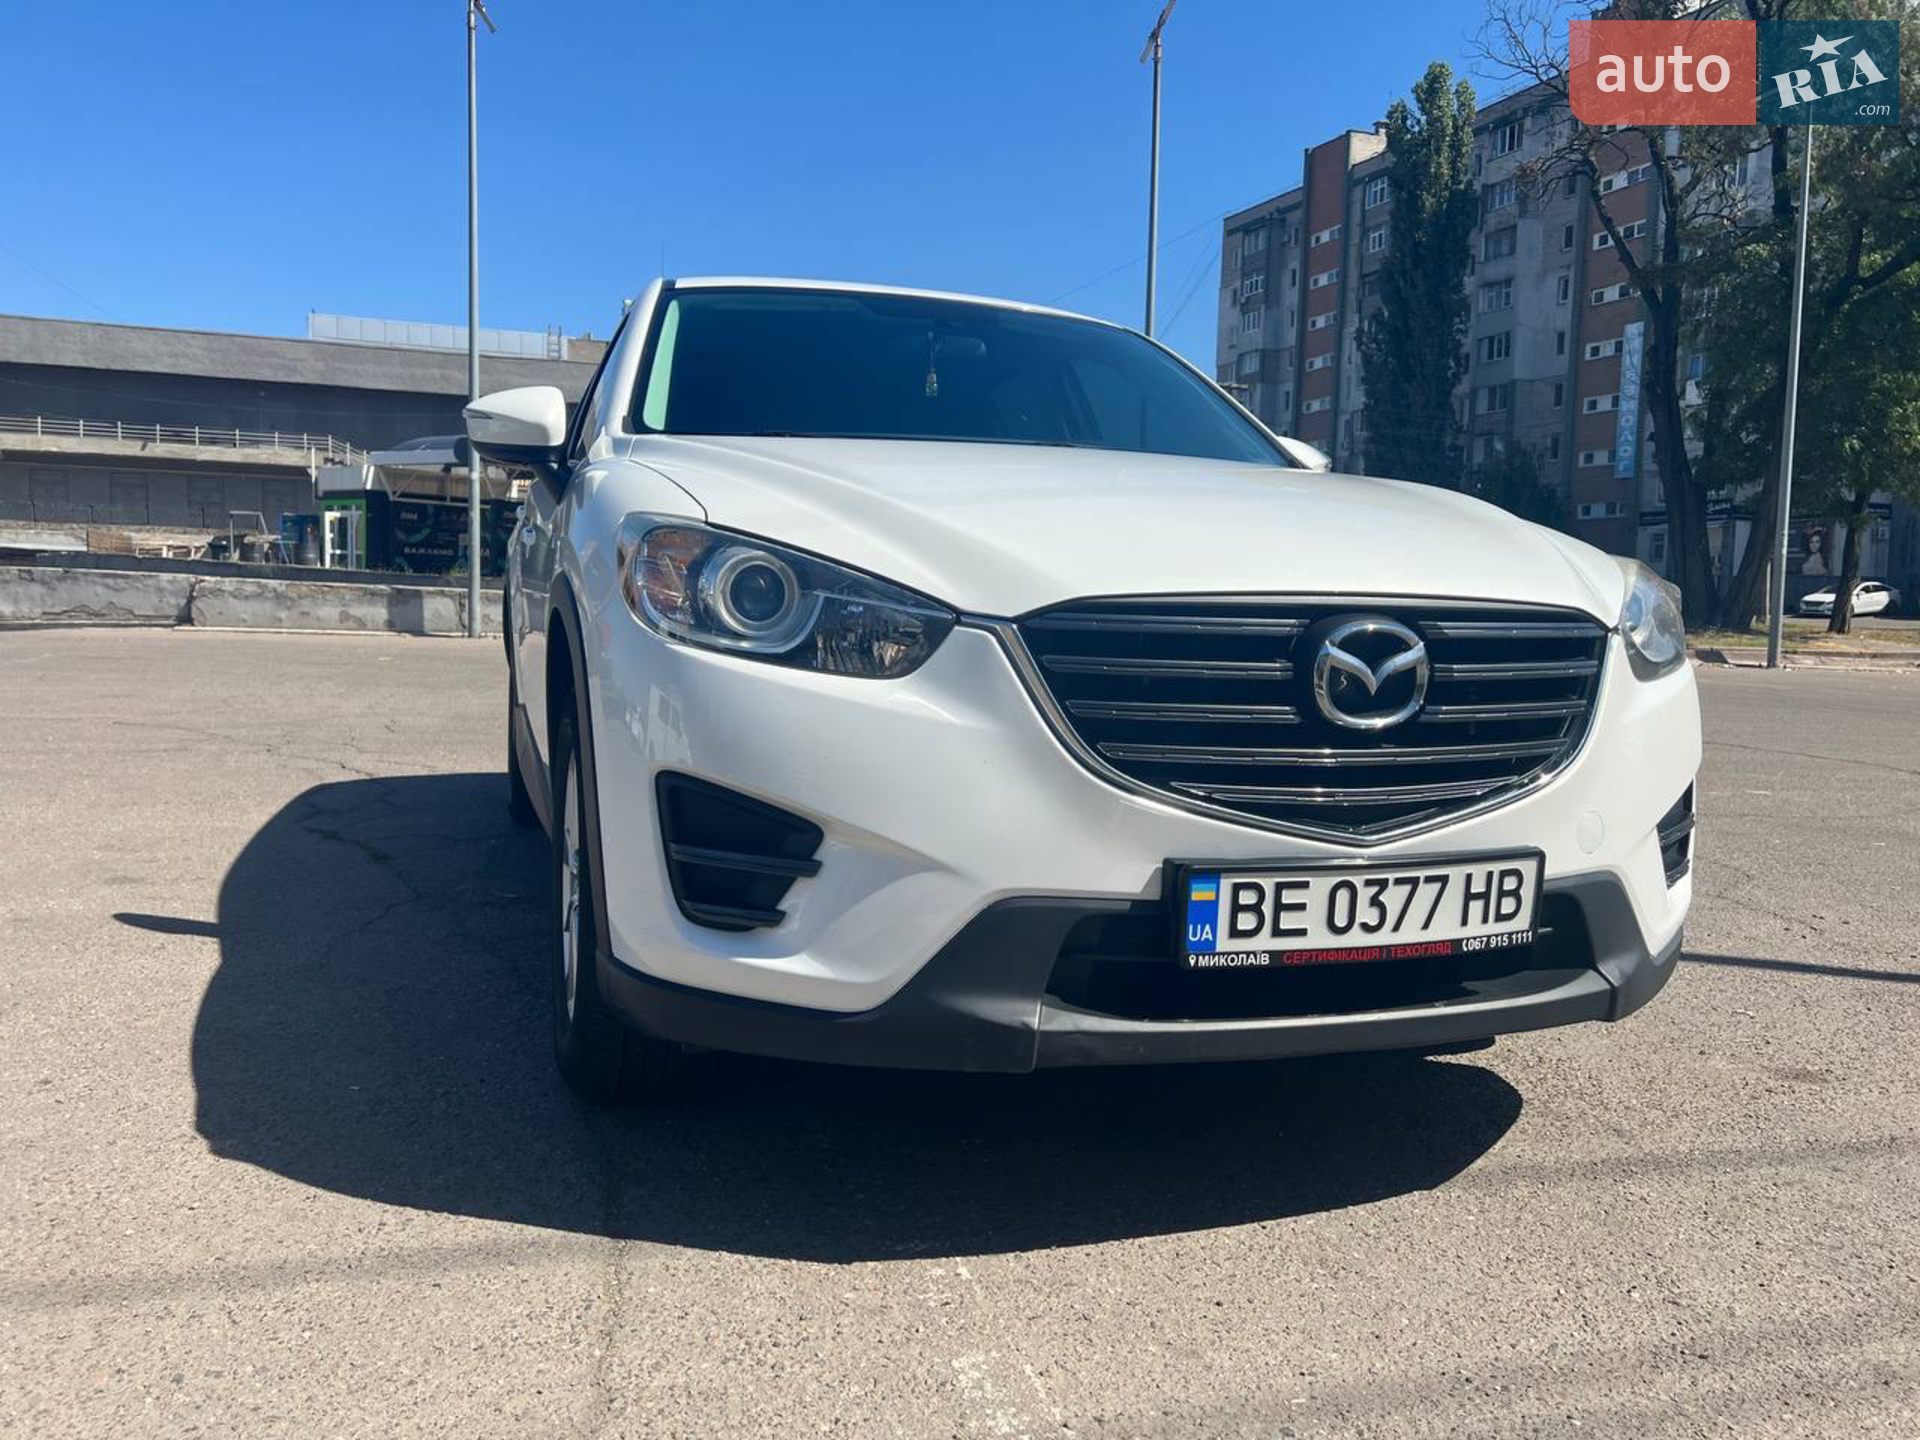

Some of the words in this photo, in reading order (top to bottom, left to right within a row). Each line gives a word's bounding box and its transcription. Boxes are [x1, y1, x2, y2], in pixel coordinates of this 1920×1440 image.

[1228, 880, 1310, 939] BE
[1327, 873, 1450, 936] 0377
[1460, 867, 1524, 927] HB
[1188, 924, 1213, 942] UA
[1198, 950, 1270, 967] МИКОЛАЇВ
[1283, 947, 1380, 964] СЕРТИФІКАЦІЯ
[1391, 942, 1452, 958] ТЕХОГЛЯД
[1468, 939, 1487, 951] 067
[1490, 934, 1509, 947] 915
[1512, 931, 1532, 944] 1111
